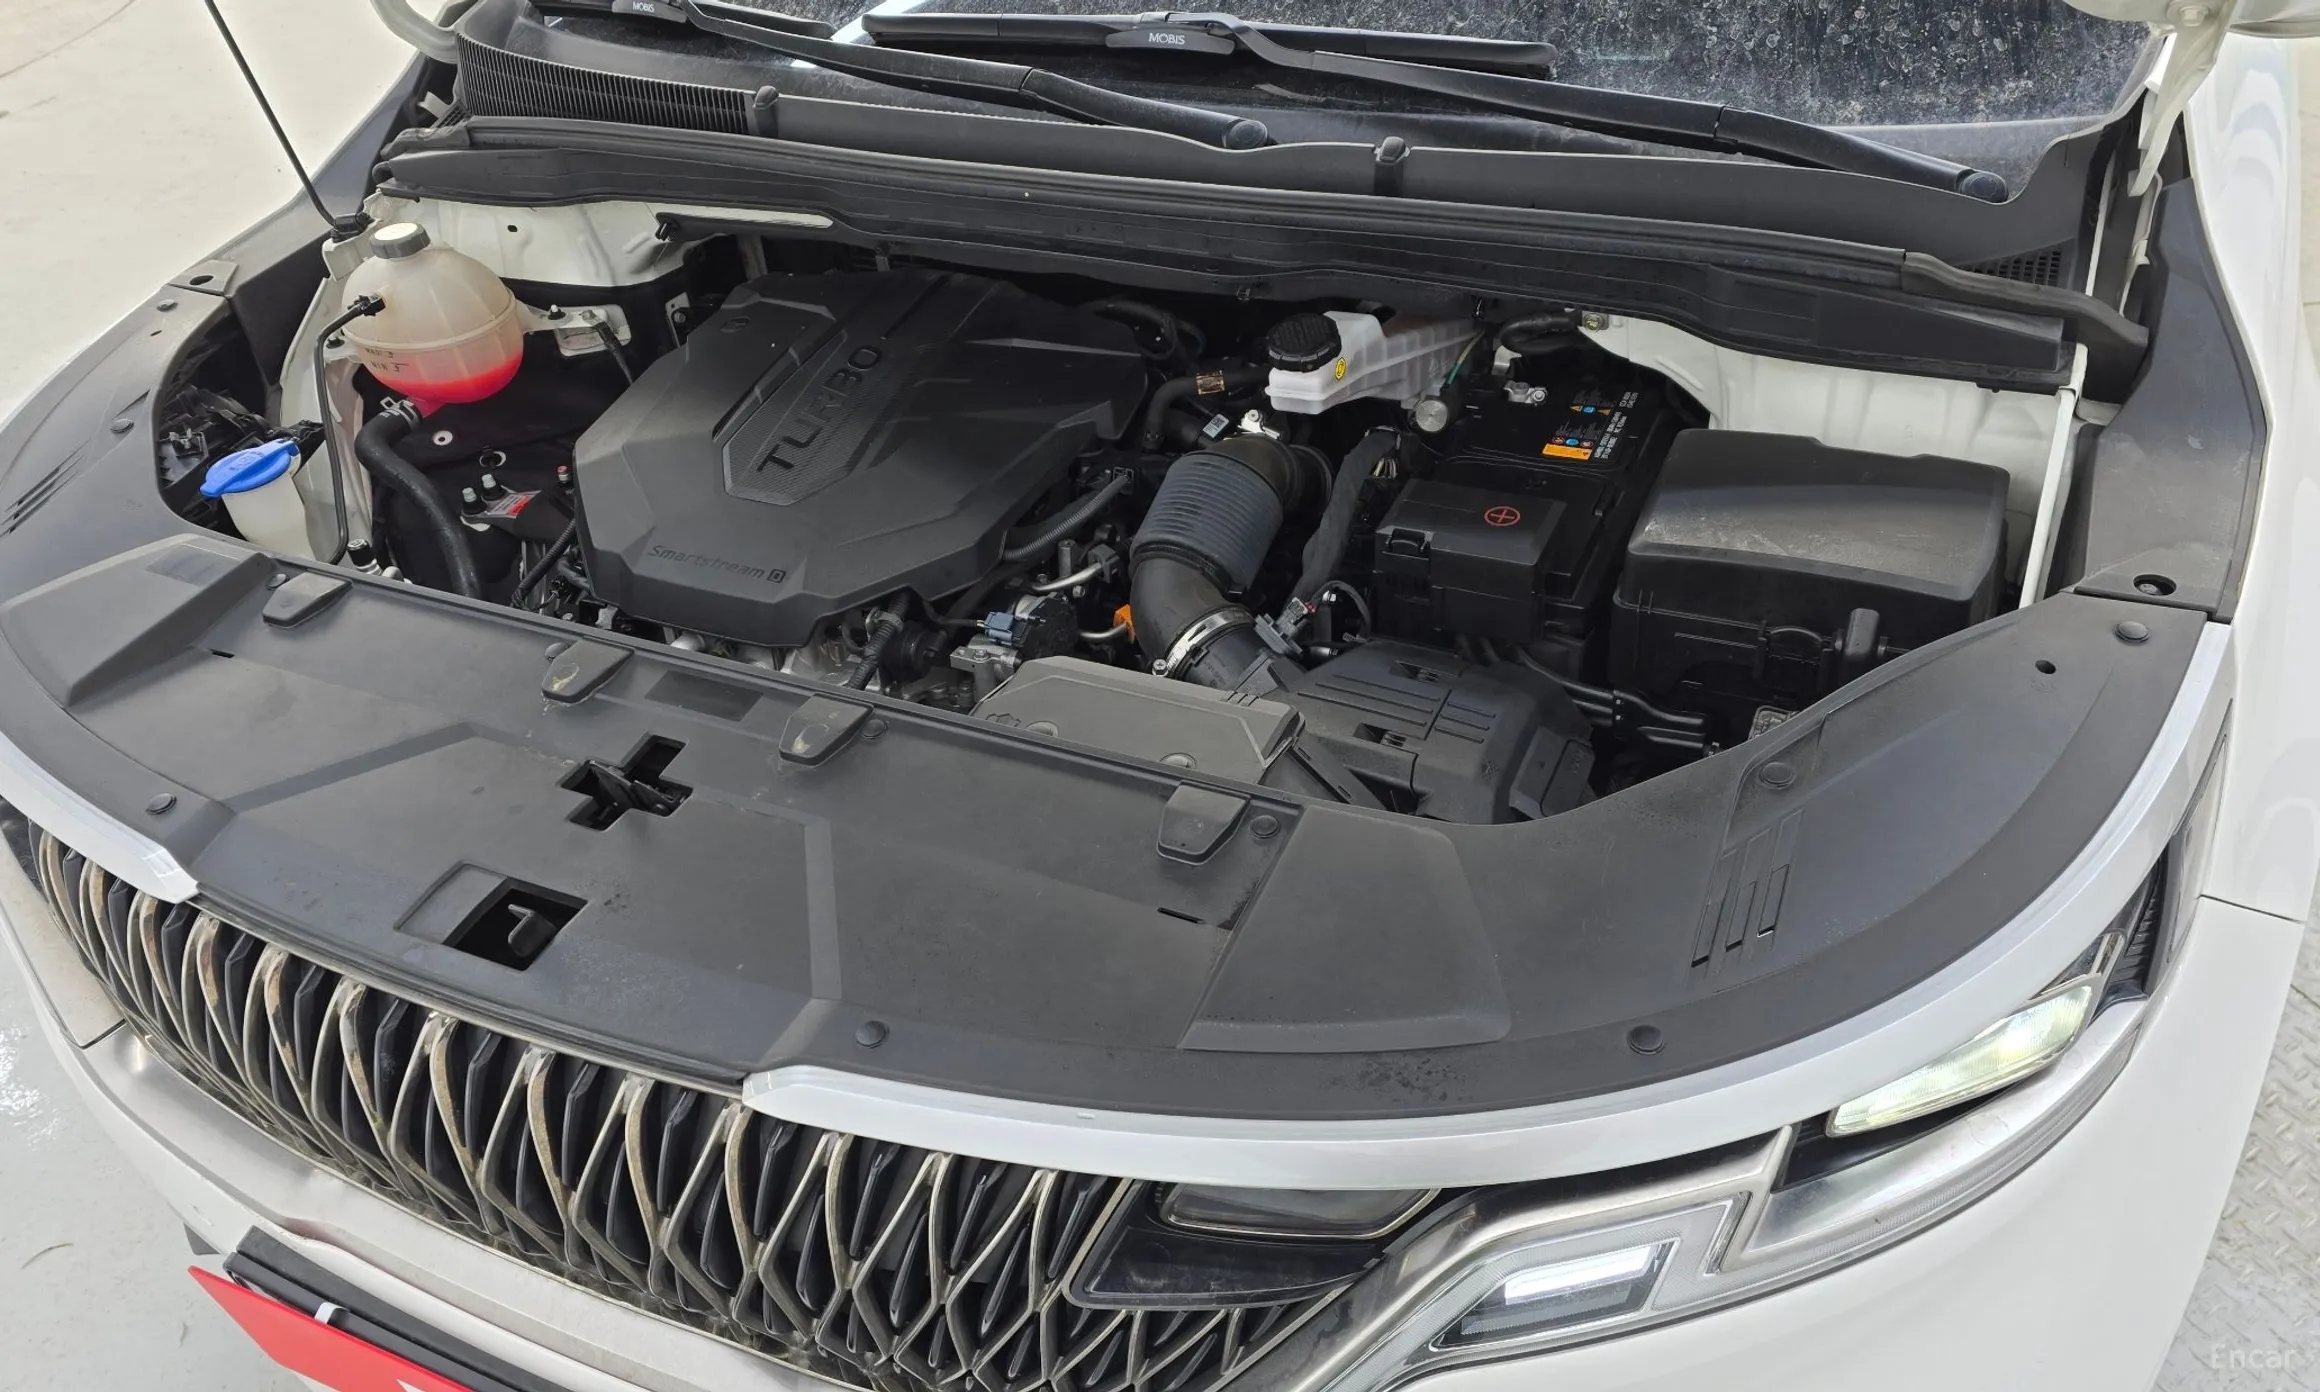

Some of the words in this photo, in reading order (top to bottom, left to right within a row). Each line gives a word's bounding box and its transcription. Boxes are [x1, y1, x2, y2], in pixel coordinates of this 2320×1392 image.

[632, 2, 654, 13] MOBIS
[1148, 32, 1186, 45] MOBIS
[756, 346, 883, 472] TURBO
[648, 545, 765, 579] Smartstream
